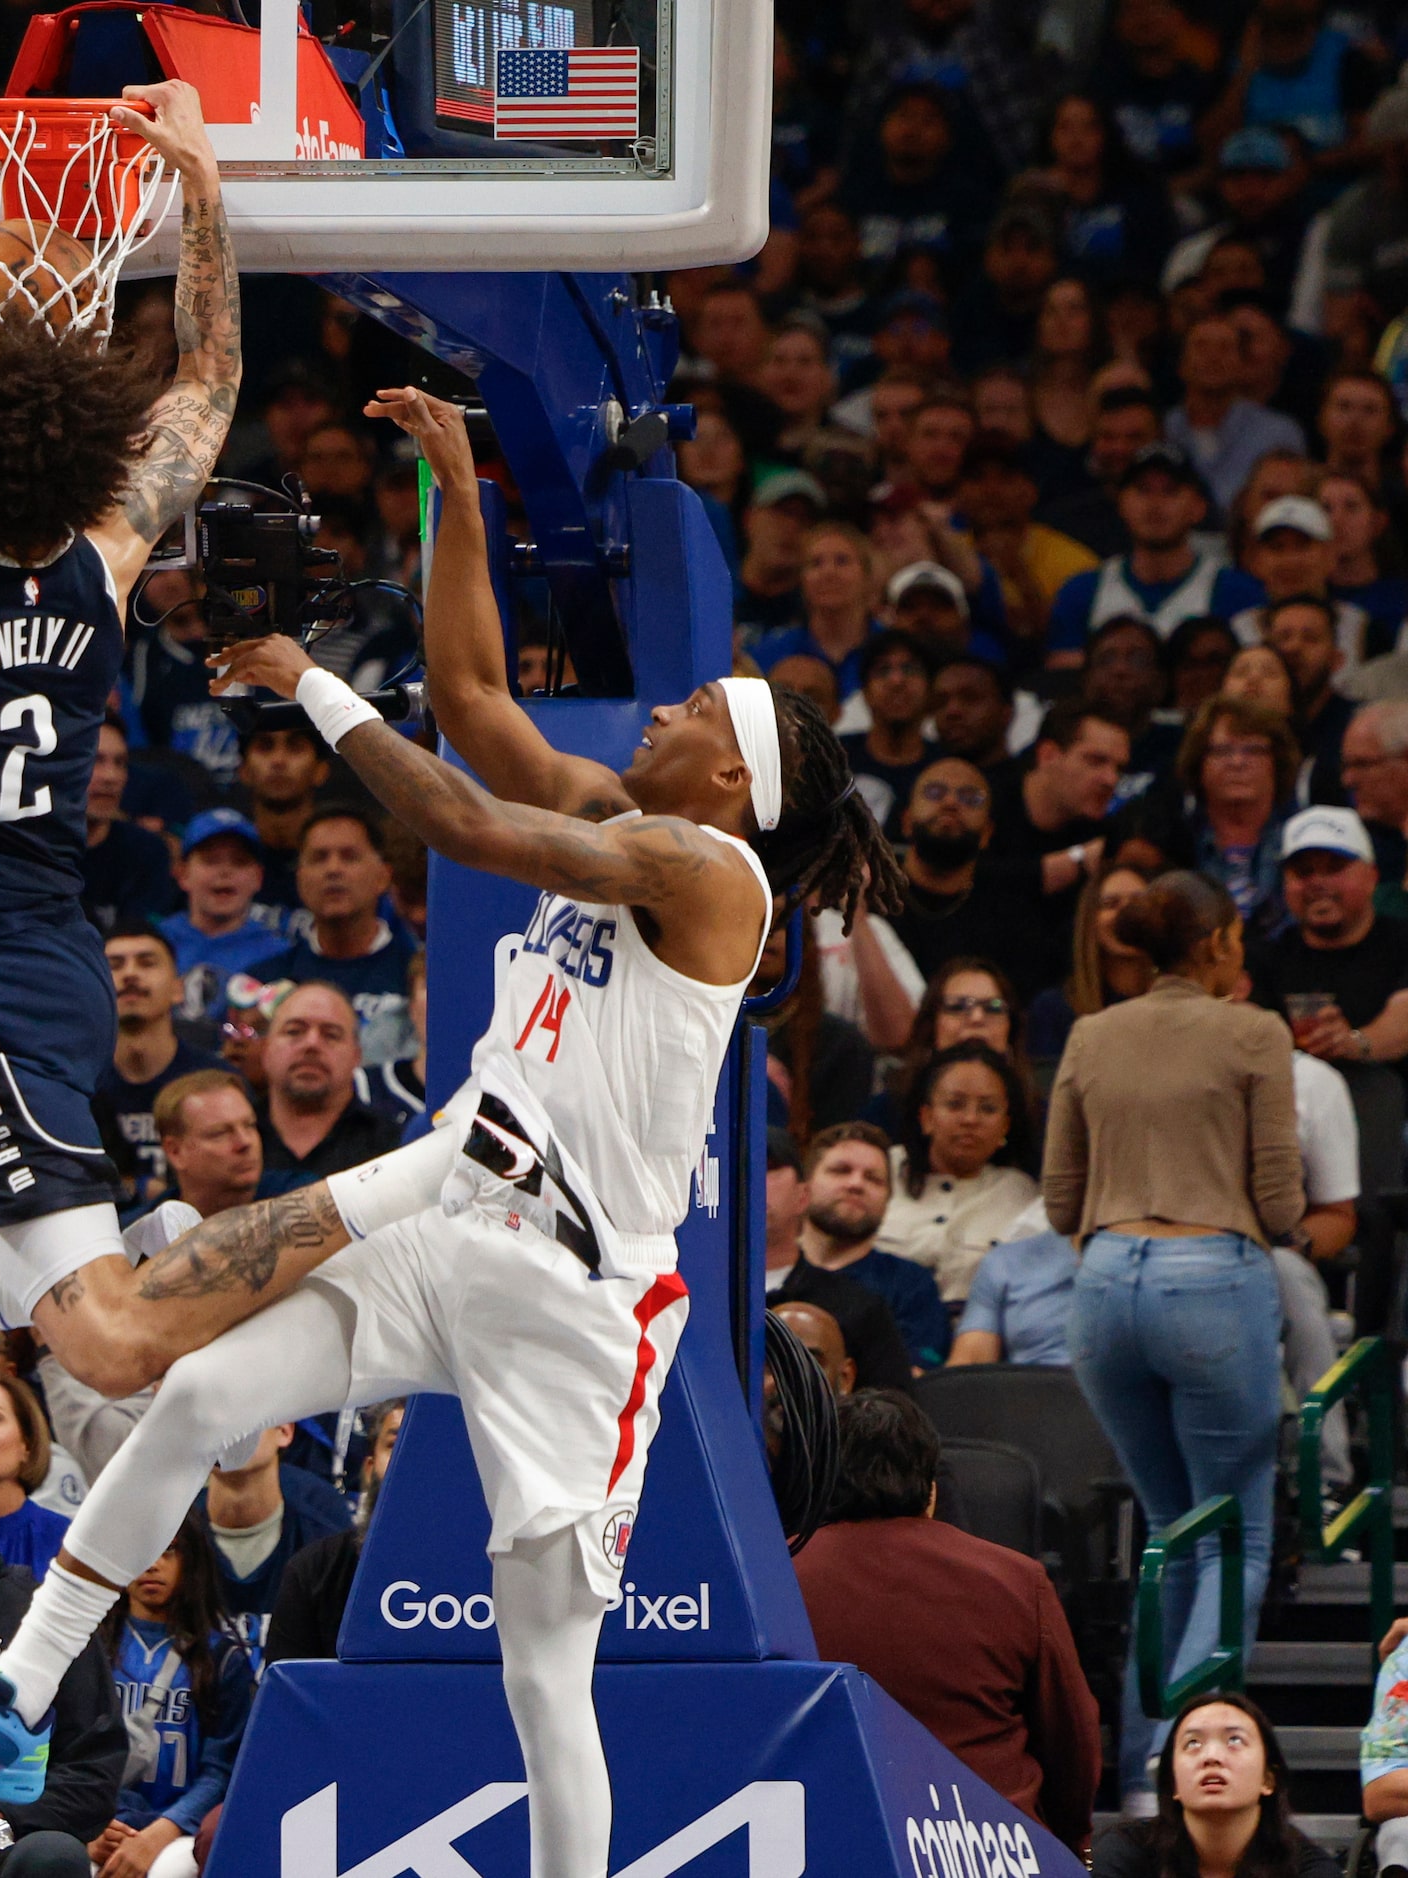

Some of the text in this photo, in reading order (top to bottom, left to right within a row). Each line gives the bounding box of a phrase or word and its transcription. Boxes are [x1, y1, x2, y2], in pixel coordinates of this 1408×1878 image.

[58, 622, 95, 671] II
[514, 973, 572, 1063] 14
[380, 1580, 496, 1630] Goo
[906, 1784, 1041, 1878] coinbase
